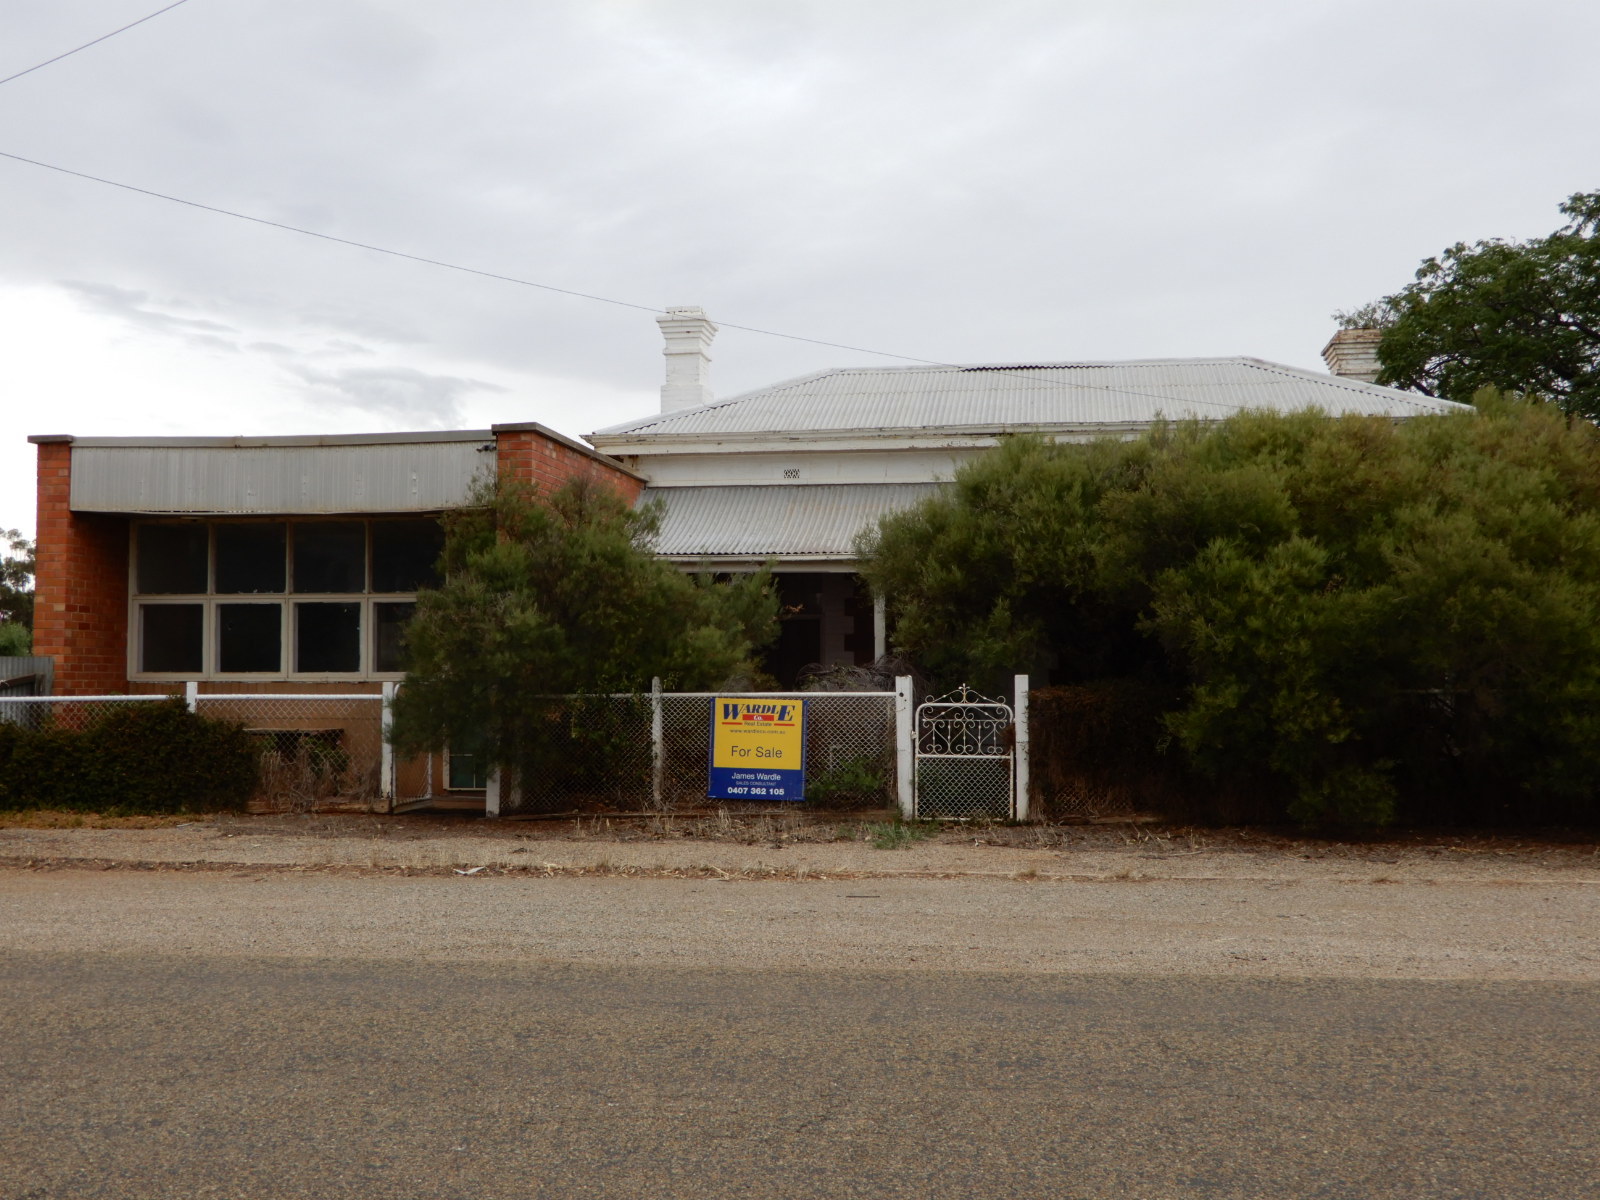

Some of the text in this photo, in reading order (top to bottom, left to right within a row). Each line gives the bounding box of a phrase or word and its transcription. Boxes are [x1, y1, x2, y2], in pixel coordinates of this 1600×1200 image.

[723, 704, 795, 721] WARDLE
[731, 746, 783, 758] For Sale
[731, 772, 781, 781] James Wardle
[727, 787, 785, 796] 0407 362 105
